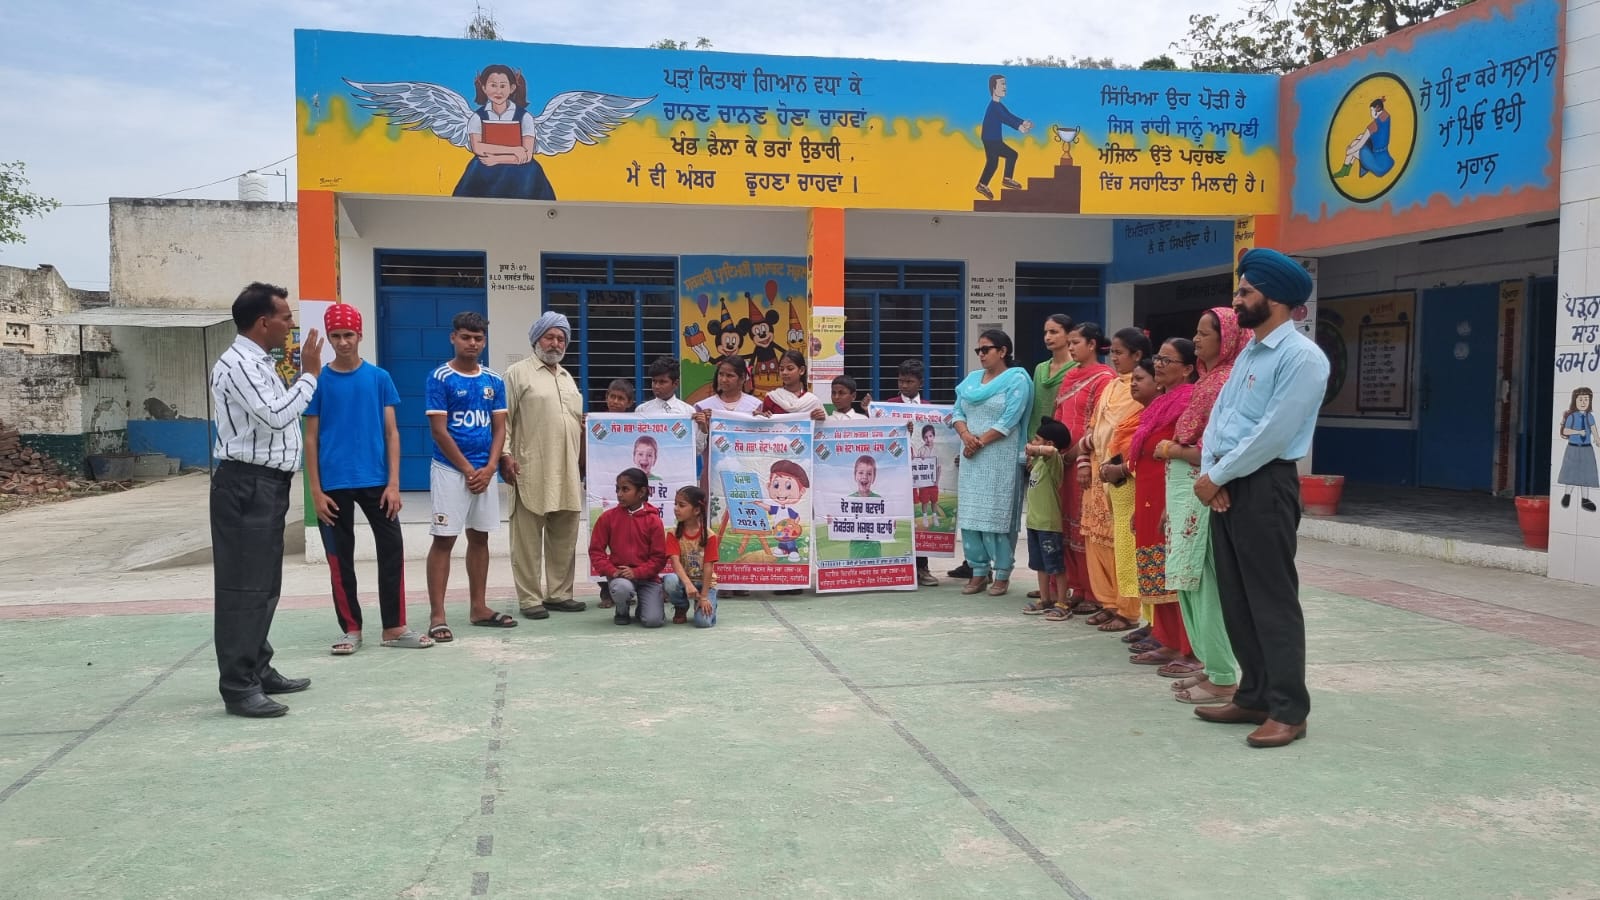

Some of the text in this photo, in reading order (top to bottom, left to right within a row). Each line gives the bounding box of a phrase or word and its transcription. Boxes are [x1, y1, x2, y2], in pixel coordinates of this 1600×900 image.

[699, 65, 747, 92] ਕਿਤਾਬਾਂ
[753, 68, 807, 94] ਗਿਆਨ
[813, 76, 841, 96] ਵਧਾ
[848, 72, 863, 95] ਕੇ
[1420, 46, 1560, 111] ਜੋ ਧੀ ਦਾ ਕਰੇ ਸਨਮਾਨ
[1101, 85, 1158, 106] ਸਿੱਖਿਆ
[1166, 88, 1191, 109] ਉਹ
[1235, 88, 1246, 109] ਹੈ
[664, 103, 710, 122] ਚਾਨਣ
[718, 106, 768, 124] ਚਾਨਣ
[776, 100, 810, 126] ਹੋਣਾ
[1439, 117, 1455, 147] ਮਾਂ
[1492, 92, 1526, 132] ਉਹੀ
[1107, 114, 1134, 134] ਜਿਸ
[1176, 116, 1203, 142] ਸਾਨੂੰ
[1208, 117, 1259, 138] ਆਪਣੀ
[670, 131, 699, 154] ਖੰਭ
[745, 135, 757, 157] ਕੇ
[764, 139, 792, 158] ਭਰਾਂ
[1150, 144, 1172, 165] ਉੱਤੇ
[1180, 144, 1227, 166] ਪਹੁੰਚਣ
[626, 160, 640, 188] ਮੈਂ
[649, 163, 666, 189] ਵੀ
[676, 164, 716, 189] ਅੰਬਰ
[745, 172, 790, 196] ਛੂਹਣਾ
[797, 172, 843, 192] ਚਾਹਵਾਂ
[1100, 171, 1123, 191] ਵਿੱਚ
[1130, 171, 1185, 192] ਸਹਾਇਤਾ
[1192, 172, 1238, 194] ਮਿਲਦੀ
[1456, 153, 1499, 189] ਮਹਾਨ
[737, 519, 757, 527] 2024
